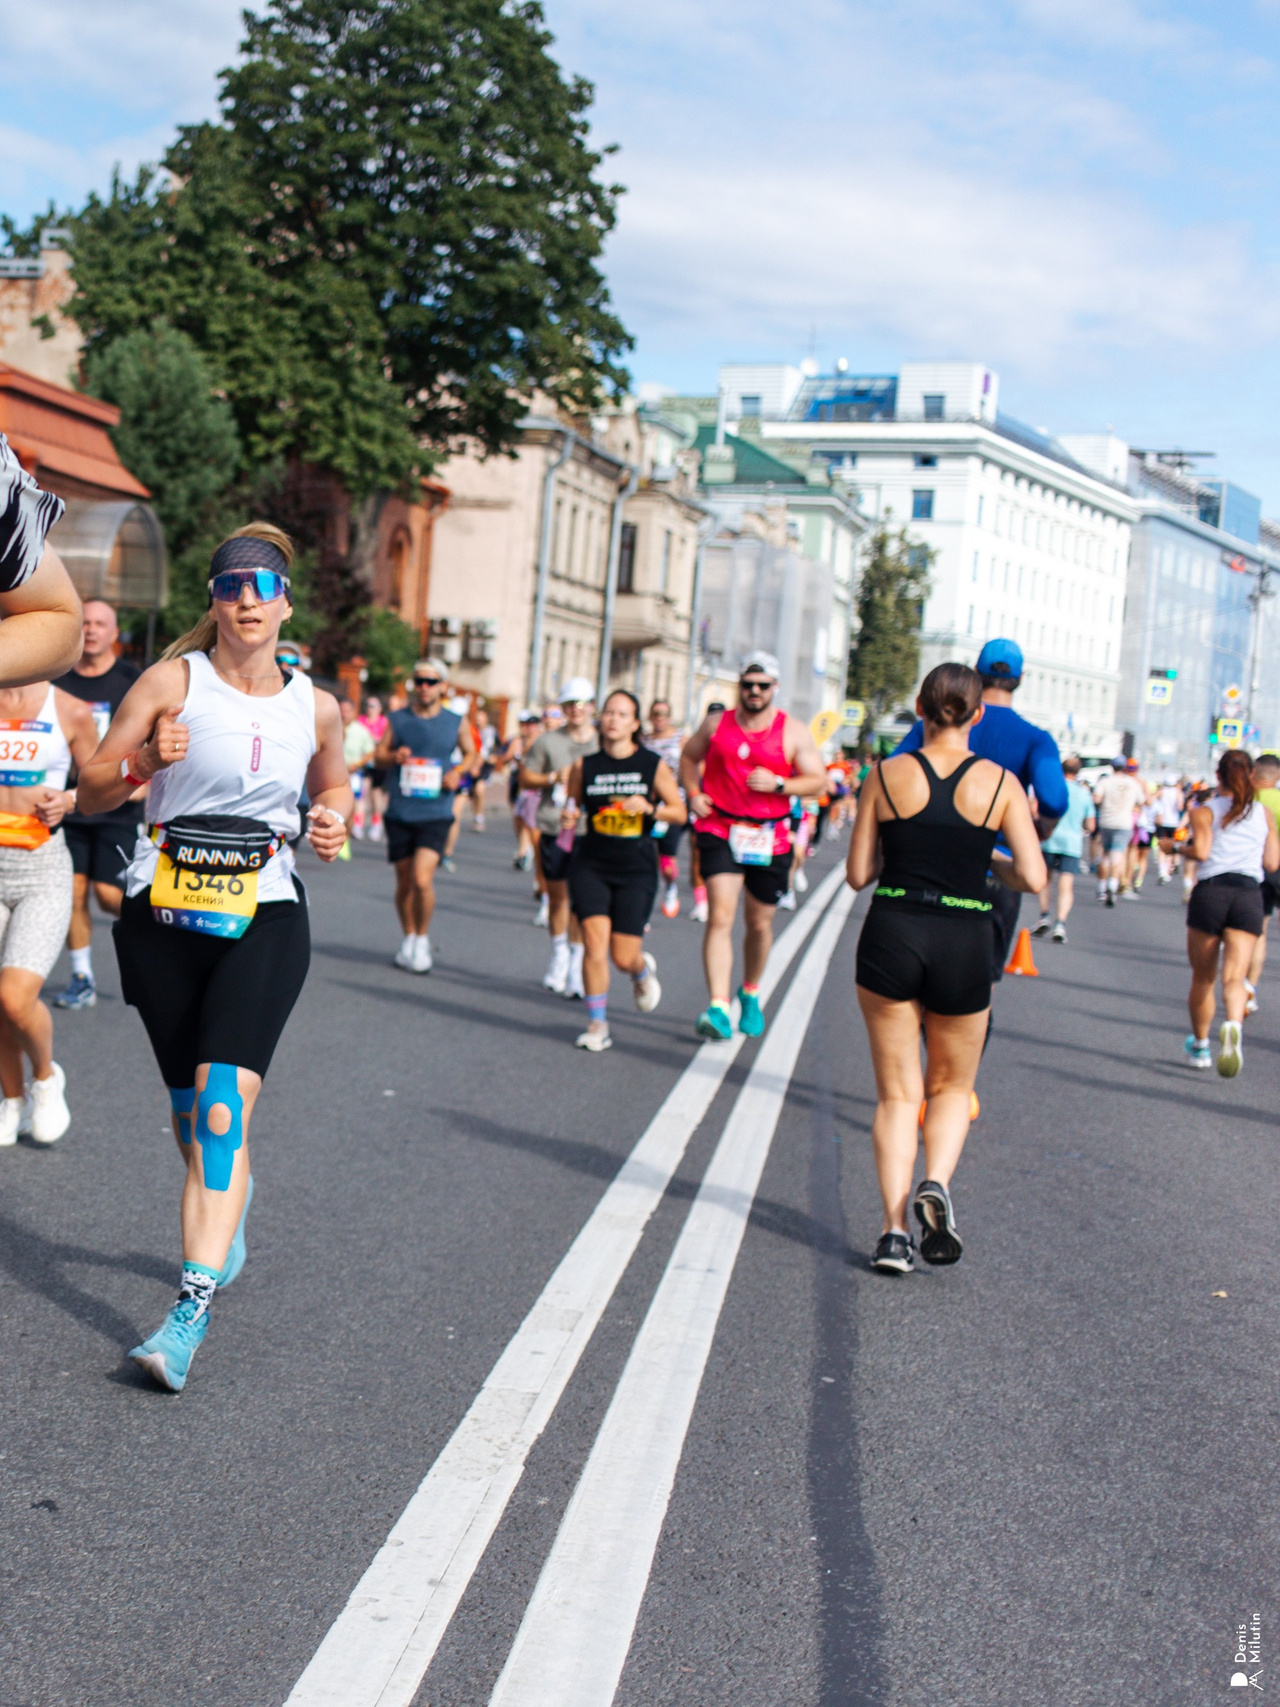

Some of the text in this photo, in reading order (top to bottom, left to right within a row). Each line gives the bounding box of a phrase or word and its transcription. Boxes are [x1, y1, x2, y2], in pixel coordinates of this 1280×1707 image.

[177, 845, 261, 868] RUNNING
[170, 862, 244, 896] 1346
[183, 894, 224, 905] КСЕНИЯ
[161, 908, 173, 924] D
